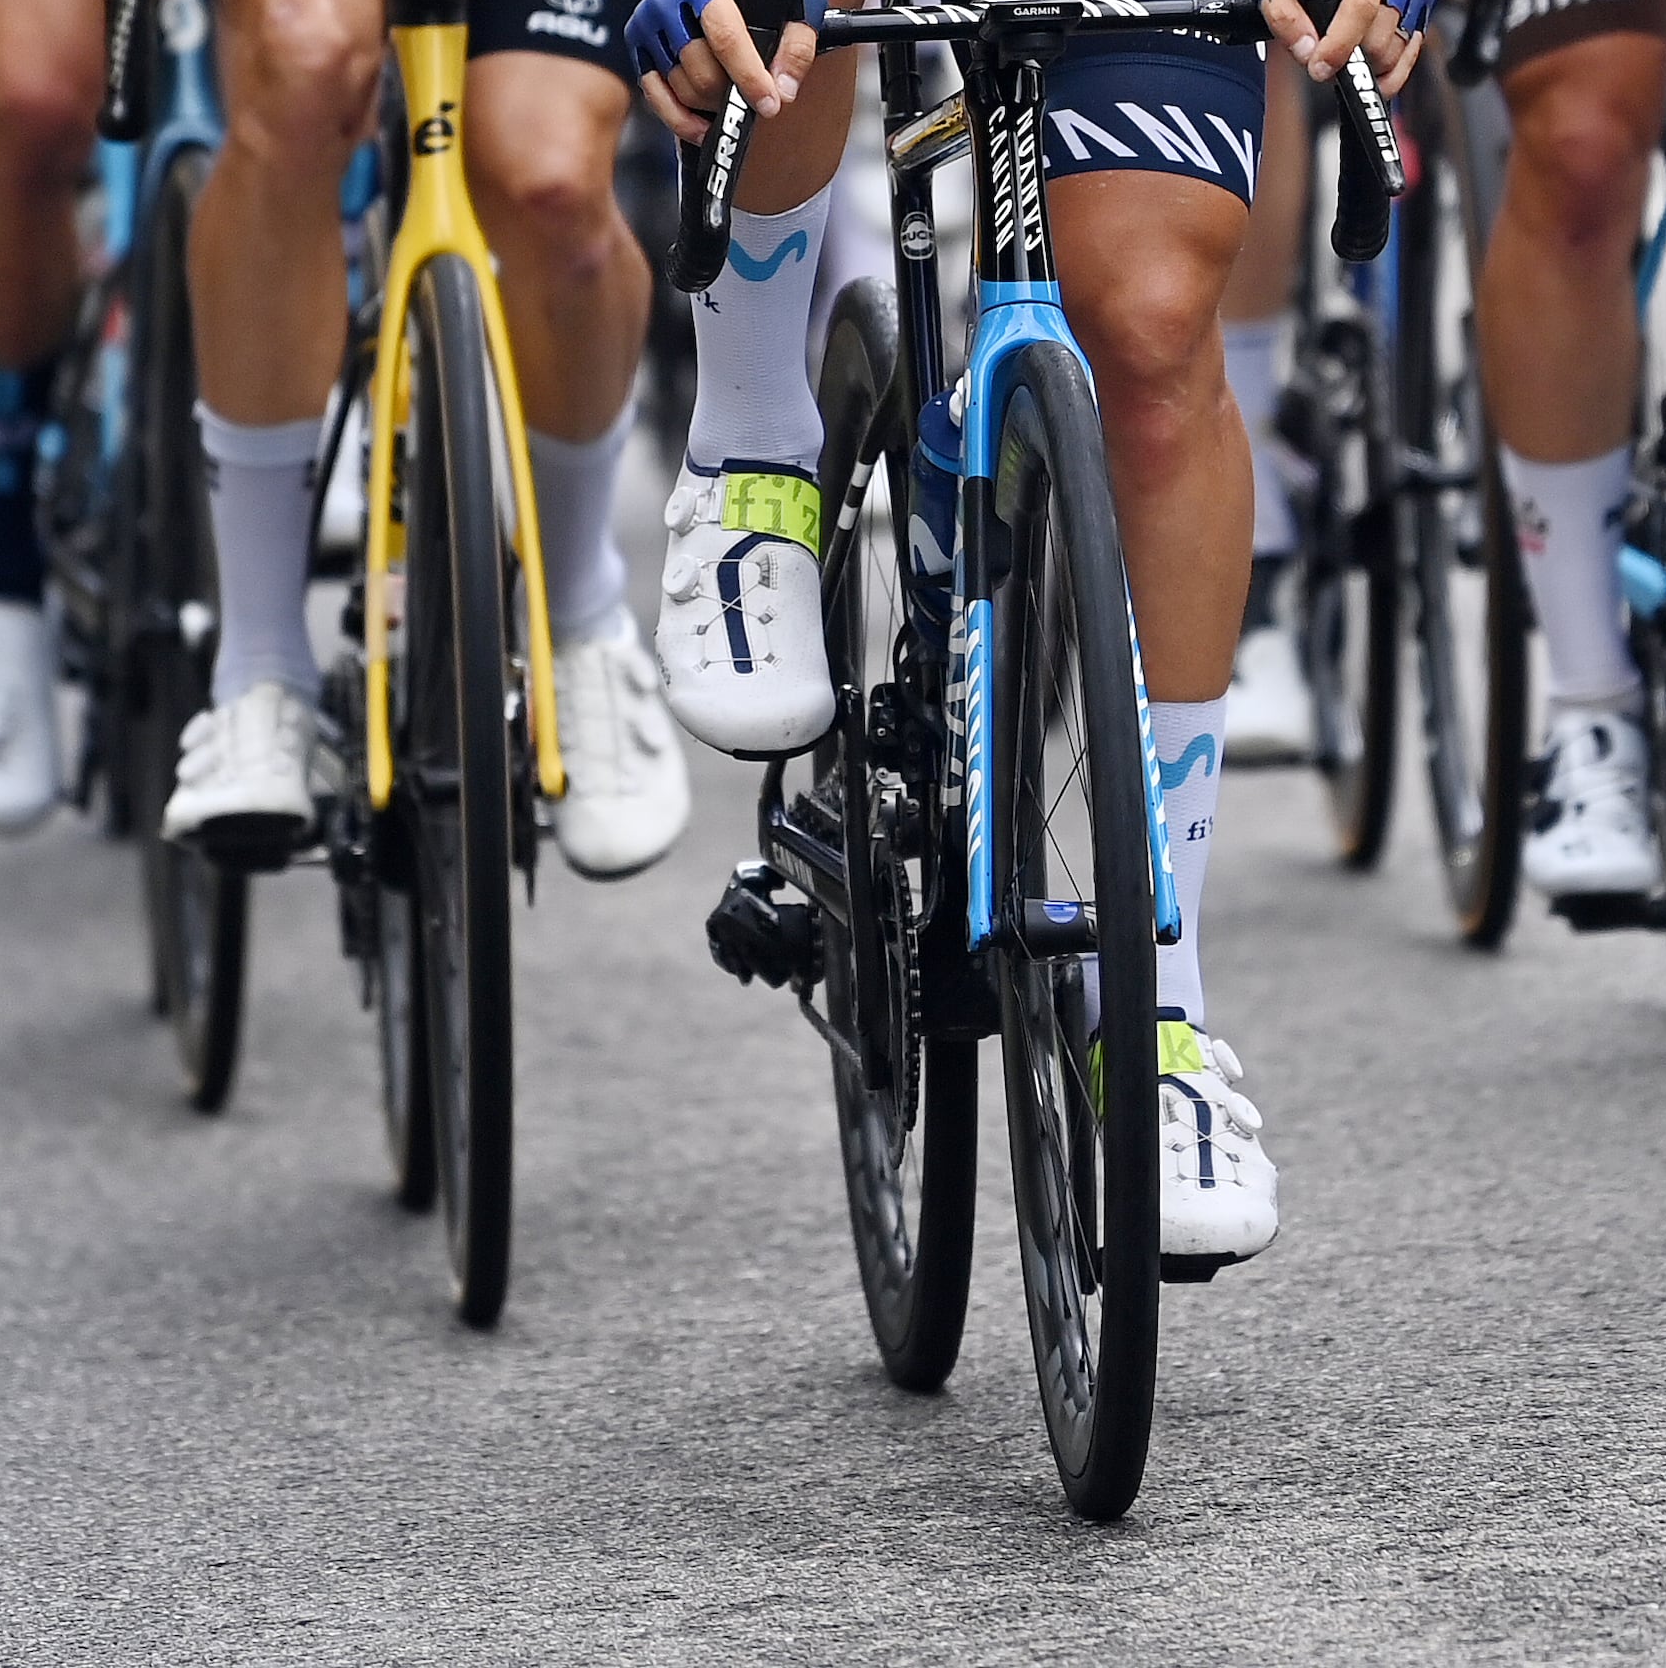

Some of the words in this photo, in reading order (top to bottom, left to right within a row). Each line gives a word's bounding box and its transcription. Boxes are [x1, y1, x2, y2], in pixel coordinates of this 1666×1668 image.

[1012, 5, 1061, 18] GARMIN
[988, 104, 1016, 254] CANYON
[1016, 106, 1044, 252] CANYON
[1042, 101, 1264, 203] ANY
